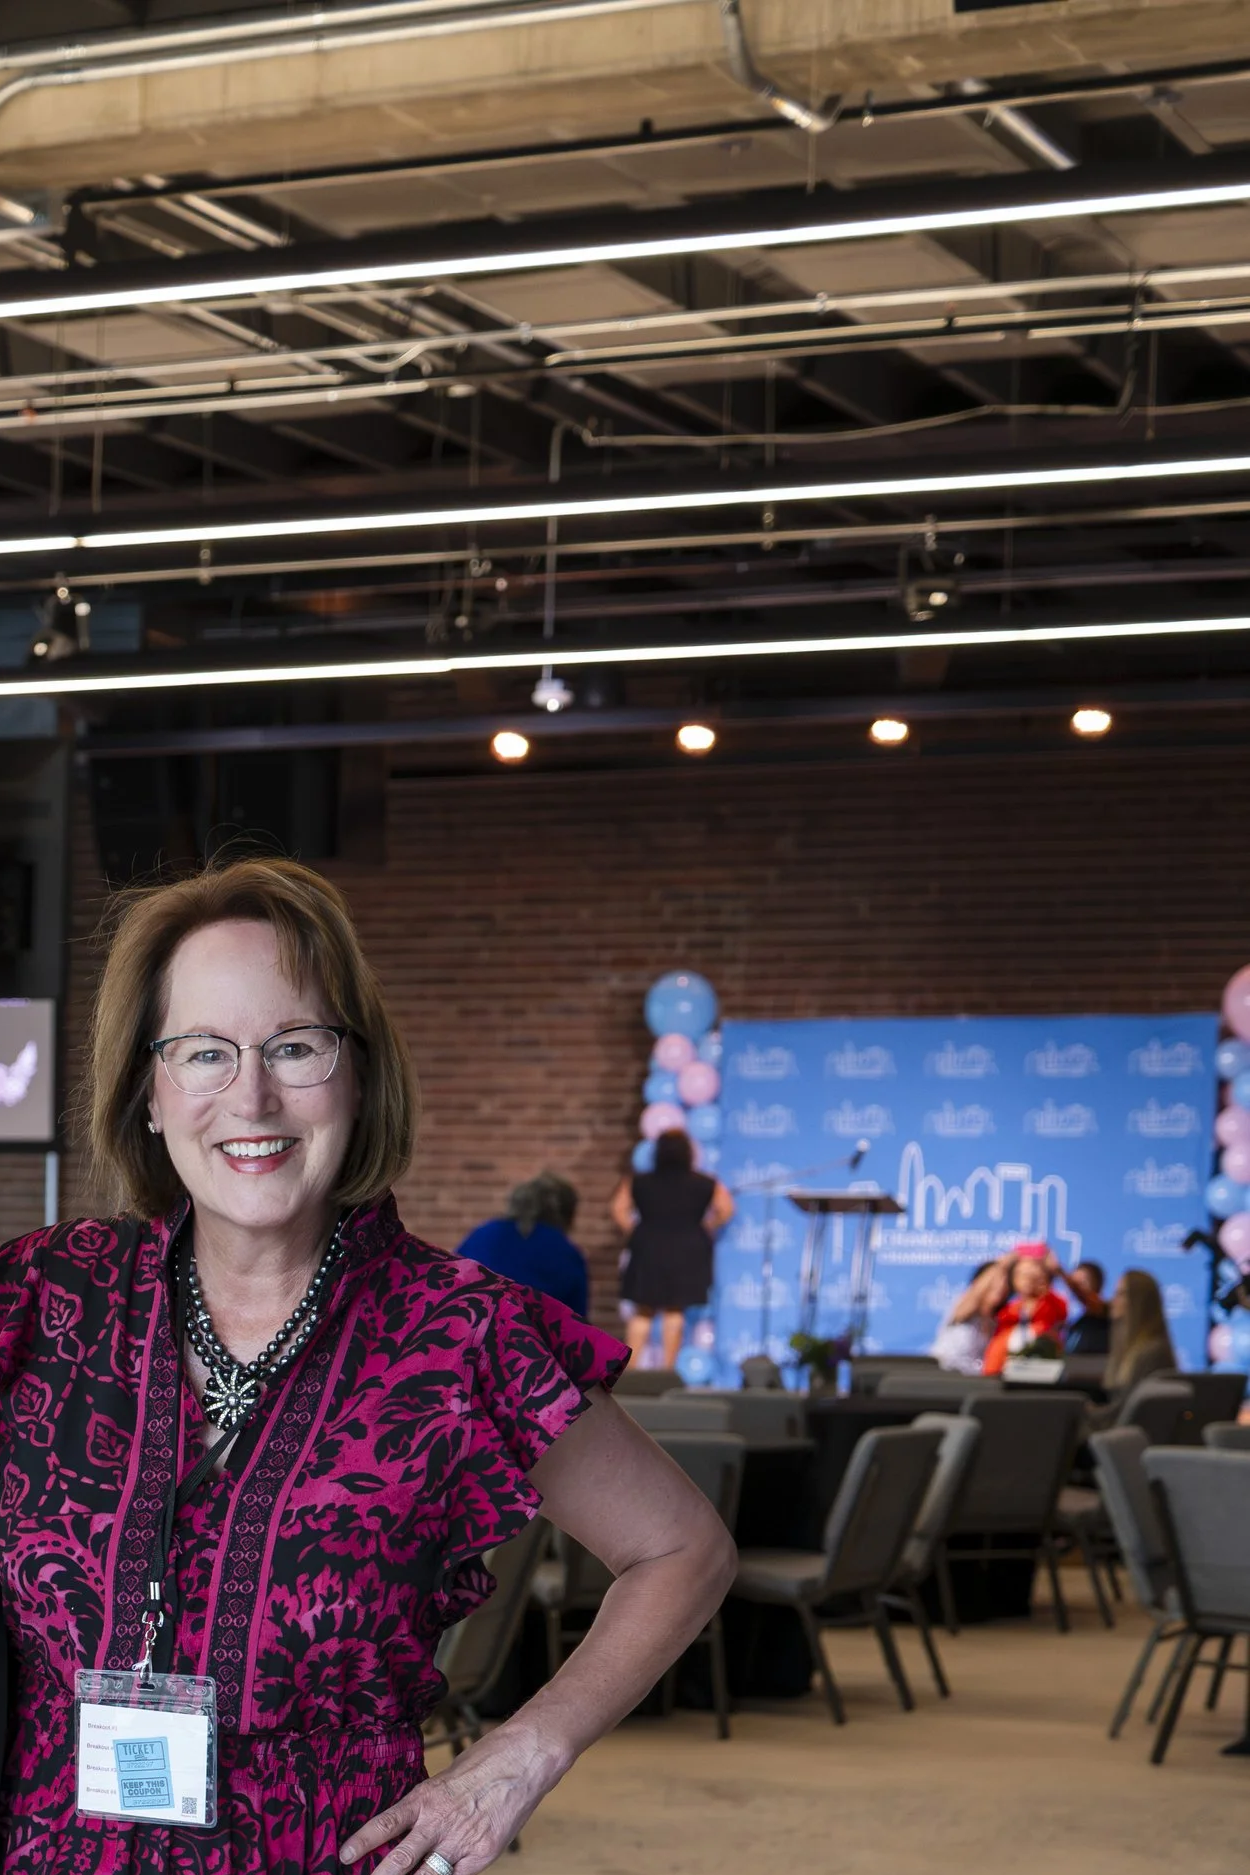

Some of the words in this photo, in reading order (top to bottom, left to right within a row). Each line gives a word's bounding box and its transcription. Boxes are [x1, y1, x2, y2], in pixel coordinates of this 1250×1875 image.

[87, 1722, 111, 1731] Breakout
[86, 1742, 110, 1750] Breakout
[123, 1744, 155, 1755] TICKET
[86, 1764, 110, 1772] Breakout
[123, 1781, 144, 1789] KEEP
[146, 1780, 166, 1788] THIS
[86, 1786, 110, 1795] Breakout
[128, 1788, 162, 1796] COUPON
